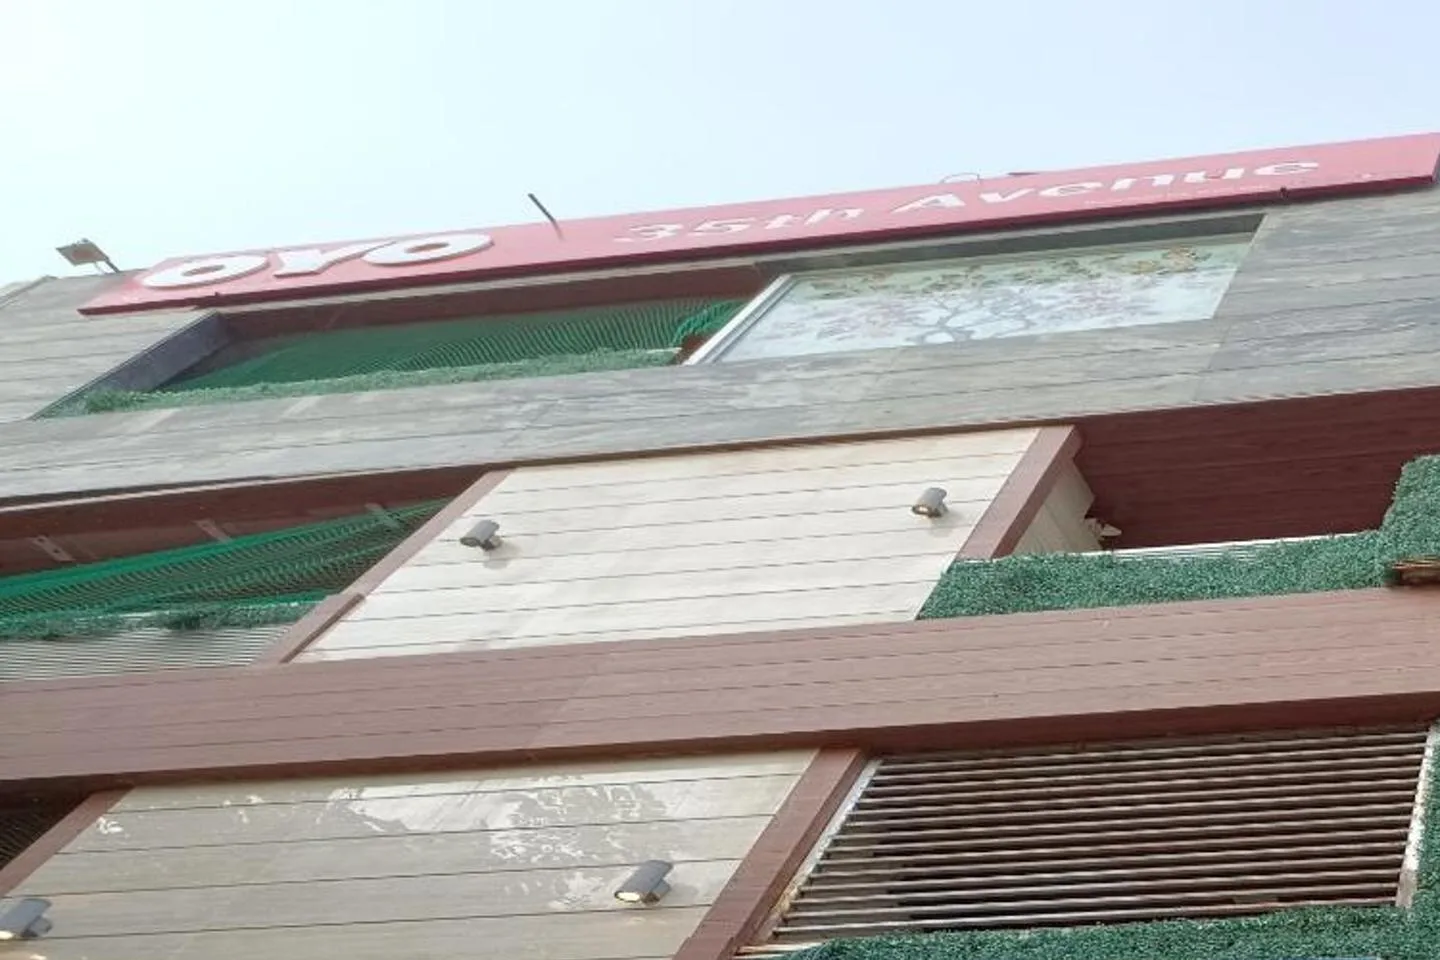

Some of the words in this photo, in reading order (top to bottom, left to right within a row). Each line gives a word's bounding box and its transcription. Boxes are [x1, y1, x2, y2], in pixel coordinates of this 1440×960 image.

[613, 208, 864, 243] 35th
[885, 160, 1320, 215] Avenue
[138, 232, 494, 291] OYO
